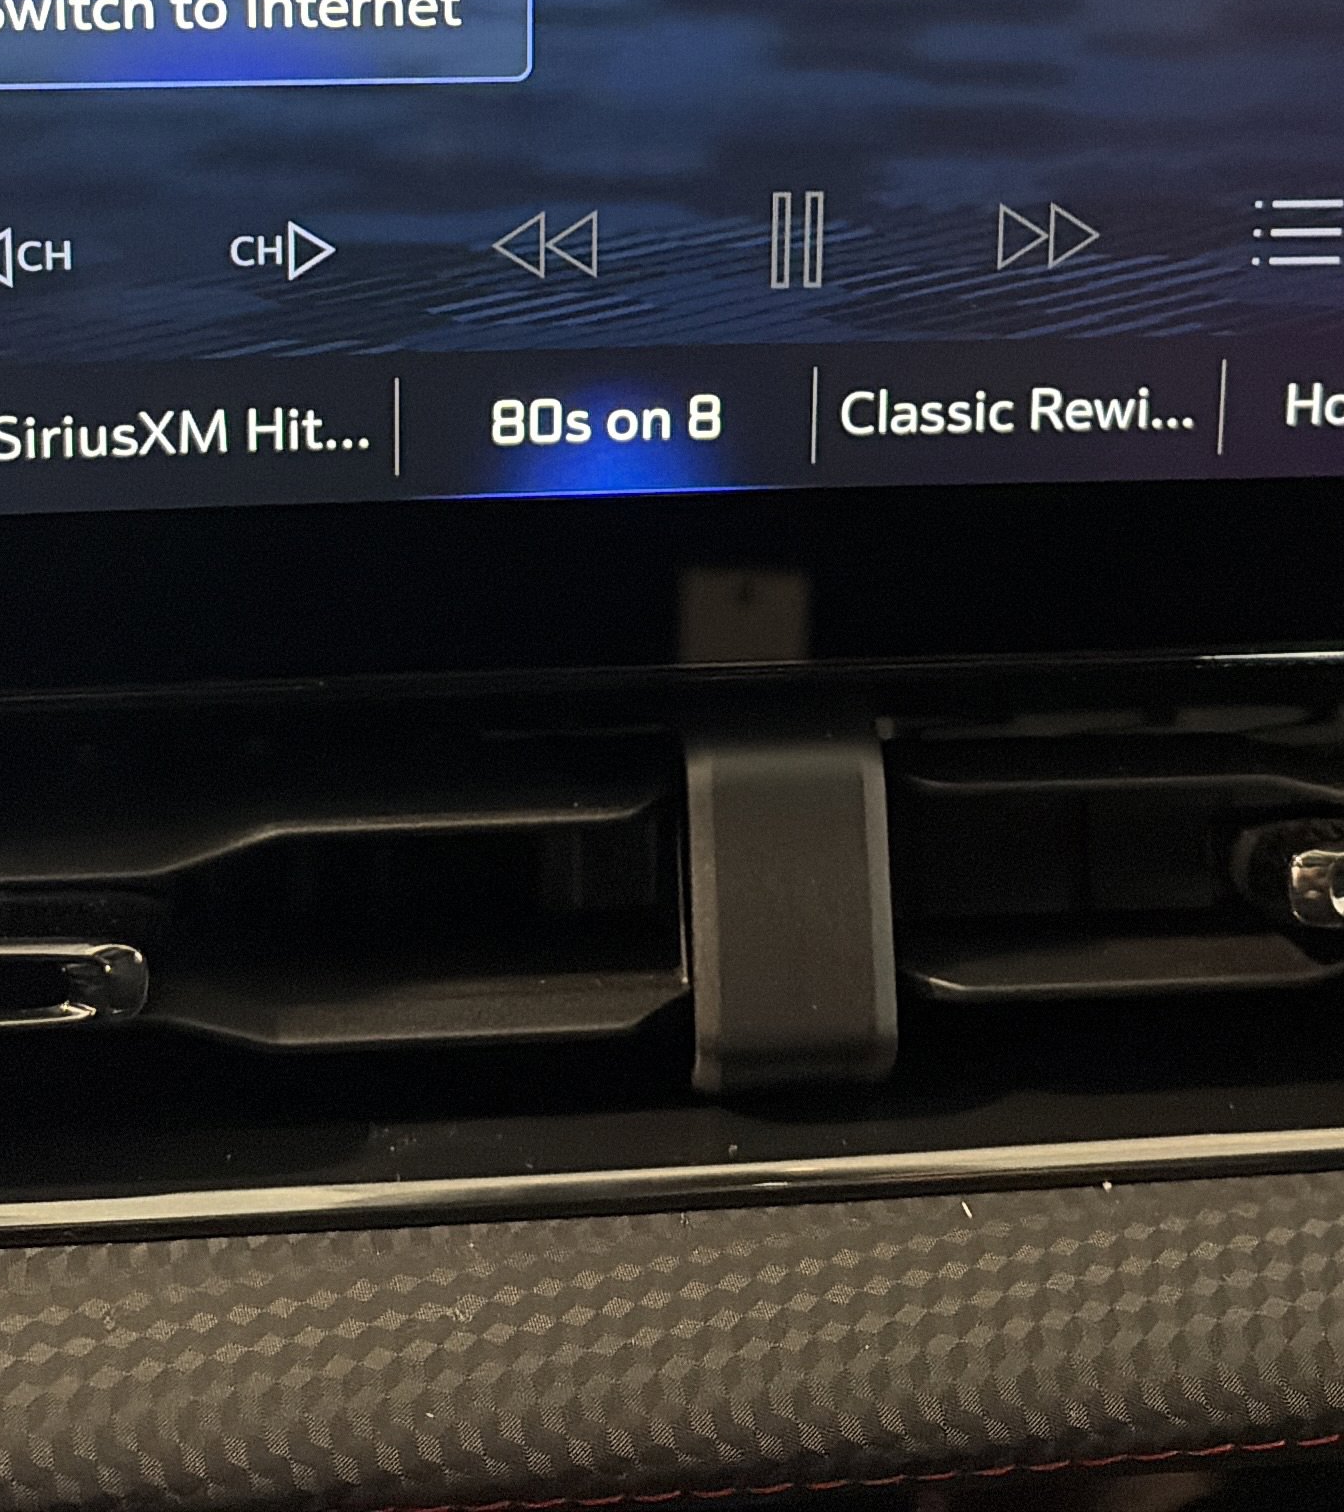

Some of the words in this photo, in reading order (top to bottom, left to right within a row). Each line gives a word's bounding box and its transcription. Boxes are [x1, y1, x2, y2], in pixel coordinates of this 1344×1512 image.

[15, 239, 73, 273] CH
[229, 234, 284, 268] CH
[490, 397, 593, 447] 80s
[605, 406, 672, 443] on
[687, 392, 722, 441] 8
[840, 387, 1016, 436] Classic
